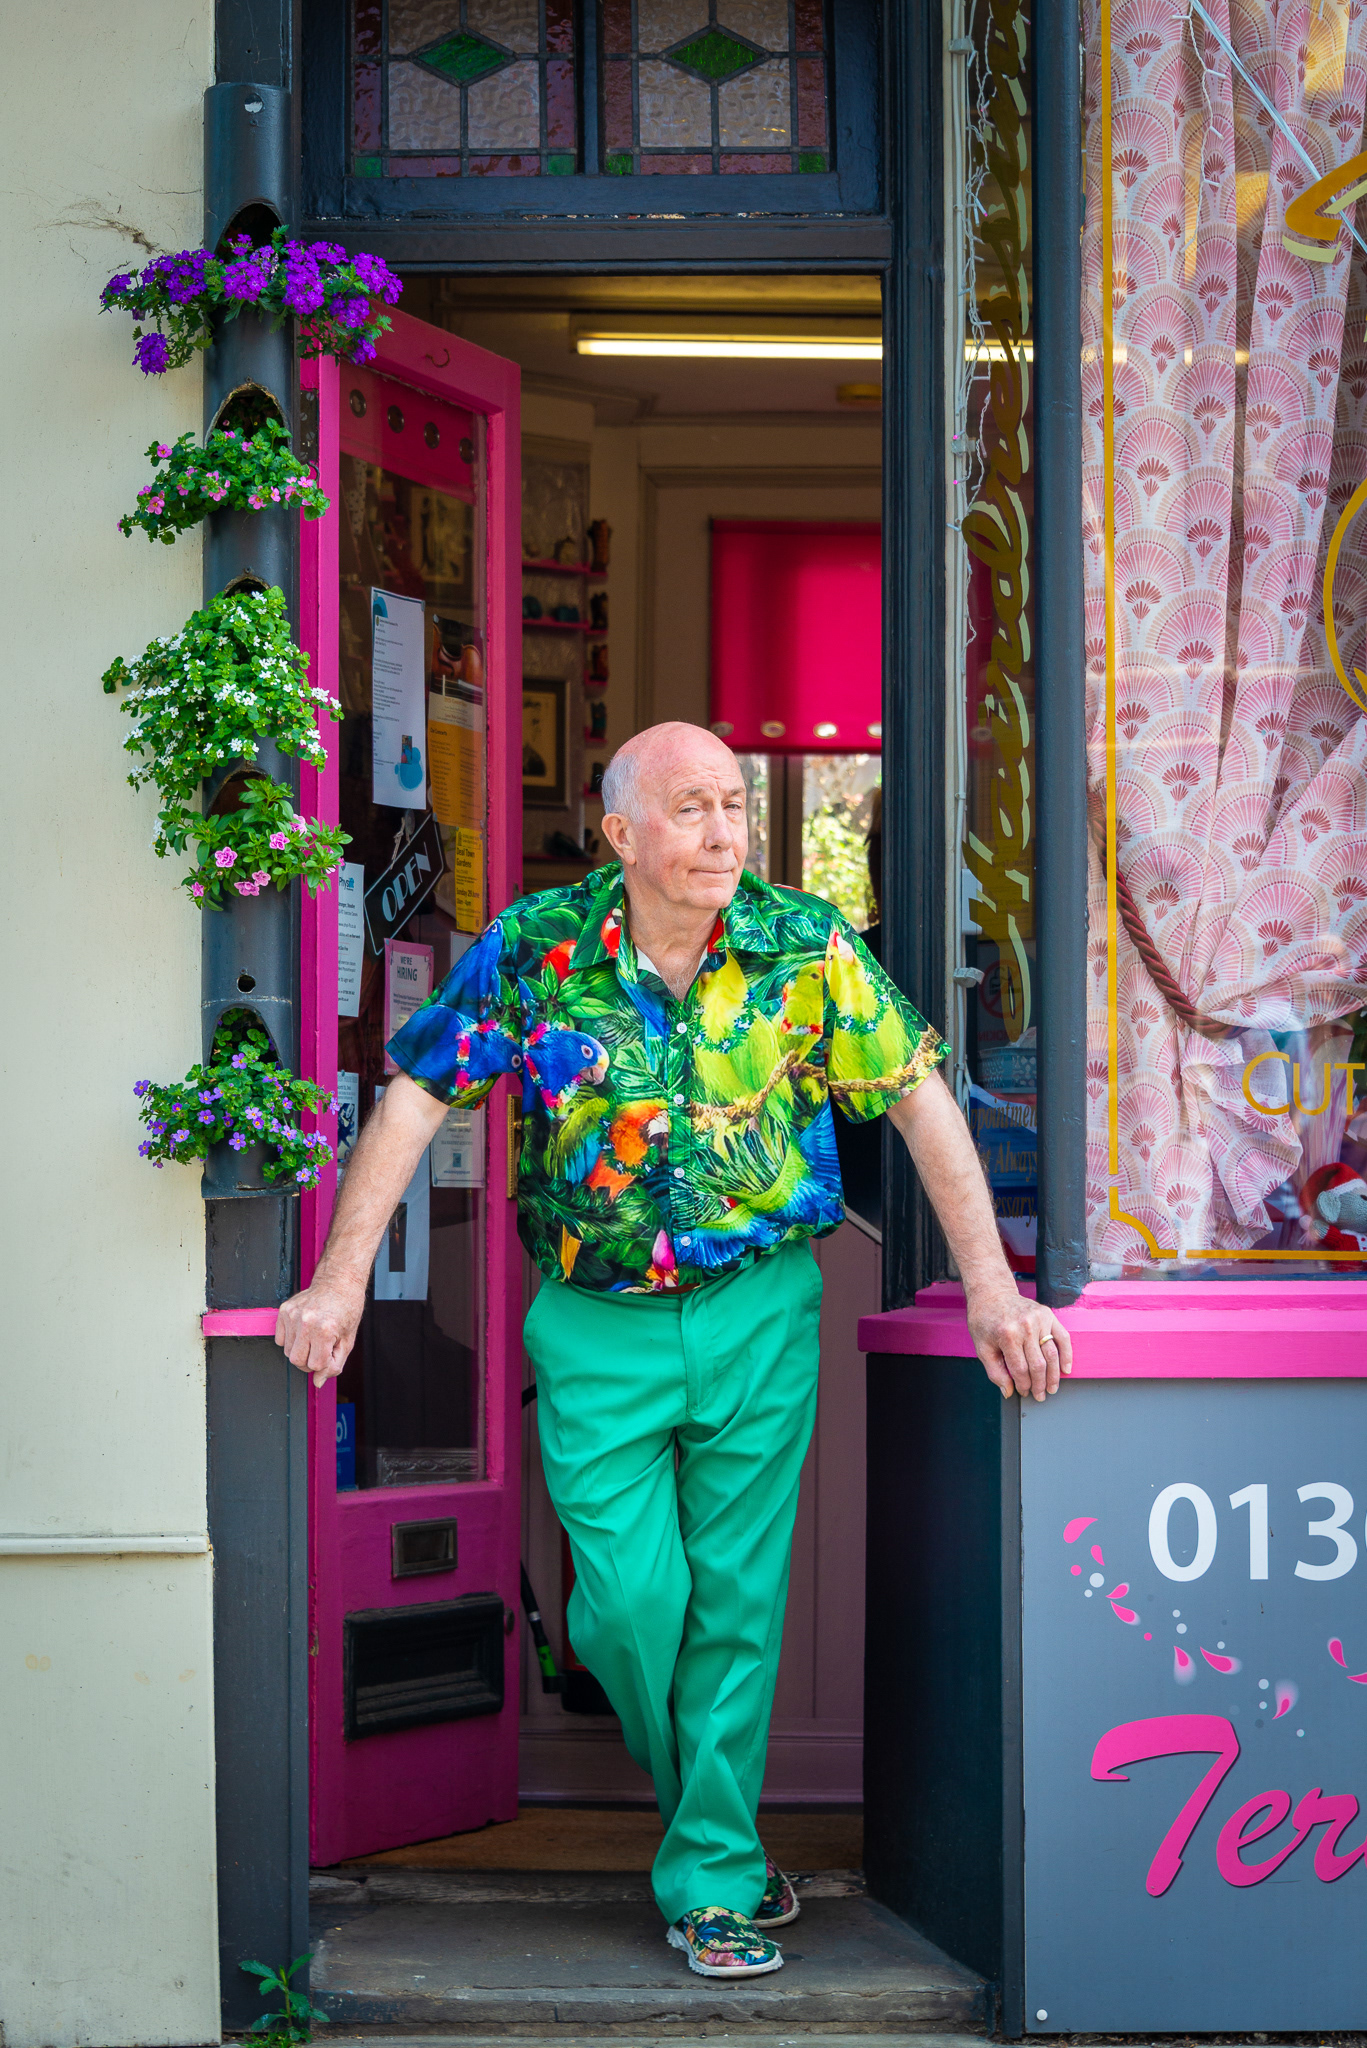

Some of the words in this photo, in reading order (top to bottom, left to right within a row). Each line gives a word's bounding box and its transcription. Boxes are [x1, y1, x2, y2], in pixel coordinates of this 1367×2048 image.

[382, 842, 431, 922] OPEN
[397, 966, 418, 981] HIRING
[400, 956, 413, 965] WE'RE
[1242, 1051, 1366, 1116] CUT
[970, 1098, 1037, 1138] ppointmen
[995, 1196, 1037, 1228] essary.
[1148, 1482, 1367, 1582] 013
[1090, 1714, 1367, 1899] Ter
